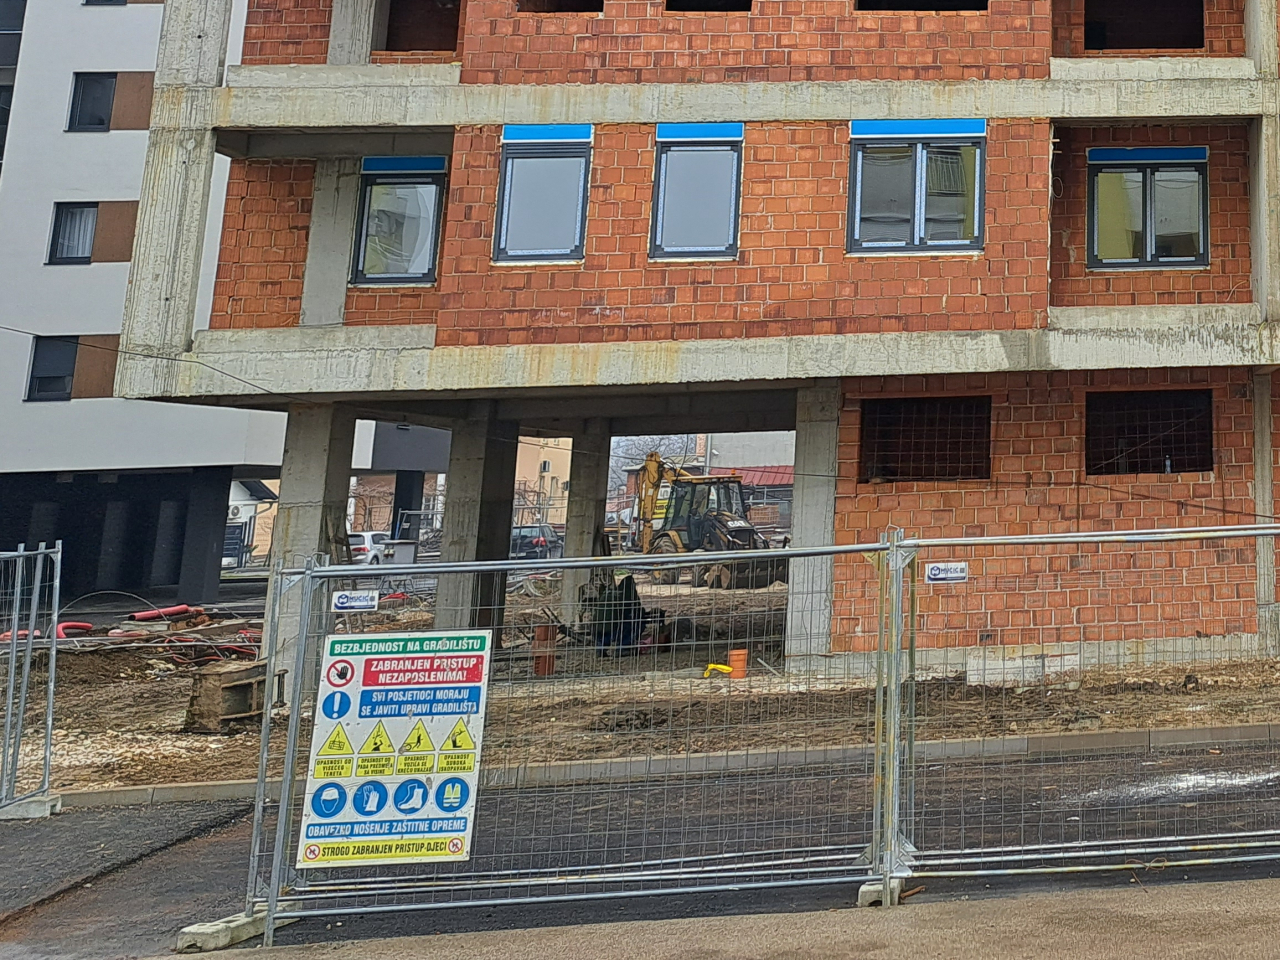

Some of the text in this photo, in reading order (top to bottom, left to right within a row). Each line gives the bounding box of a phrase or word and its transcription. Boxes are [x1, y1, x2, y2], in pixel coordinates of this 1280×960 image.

[334, 638, 480, 654] BEZBJEDNOST NA GRADILIŠTU
[371, 657, 477, 671] ZABRANJEN PRISTUP
[378, 670, 467, 684] NEZAPOSLENIMA!
[372, 689, 469, 702] SVI POSJETIOCI MORAJU
[361, 700, 477, 716] SE JAVITI UPRAVI GRADILIŠTA
[308, 819, 465, 837] OBAVEZNO NOŠENJE ZAŠTITNE OPREME
[321, 845, 350, 857] STROGO
[351, 843, 394, 856] ZABRANJEN
